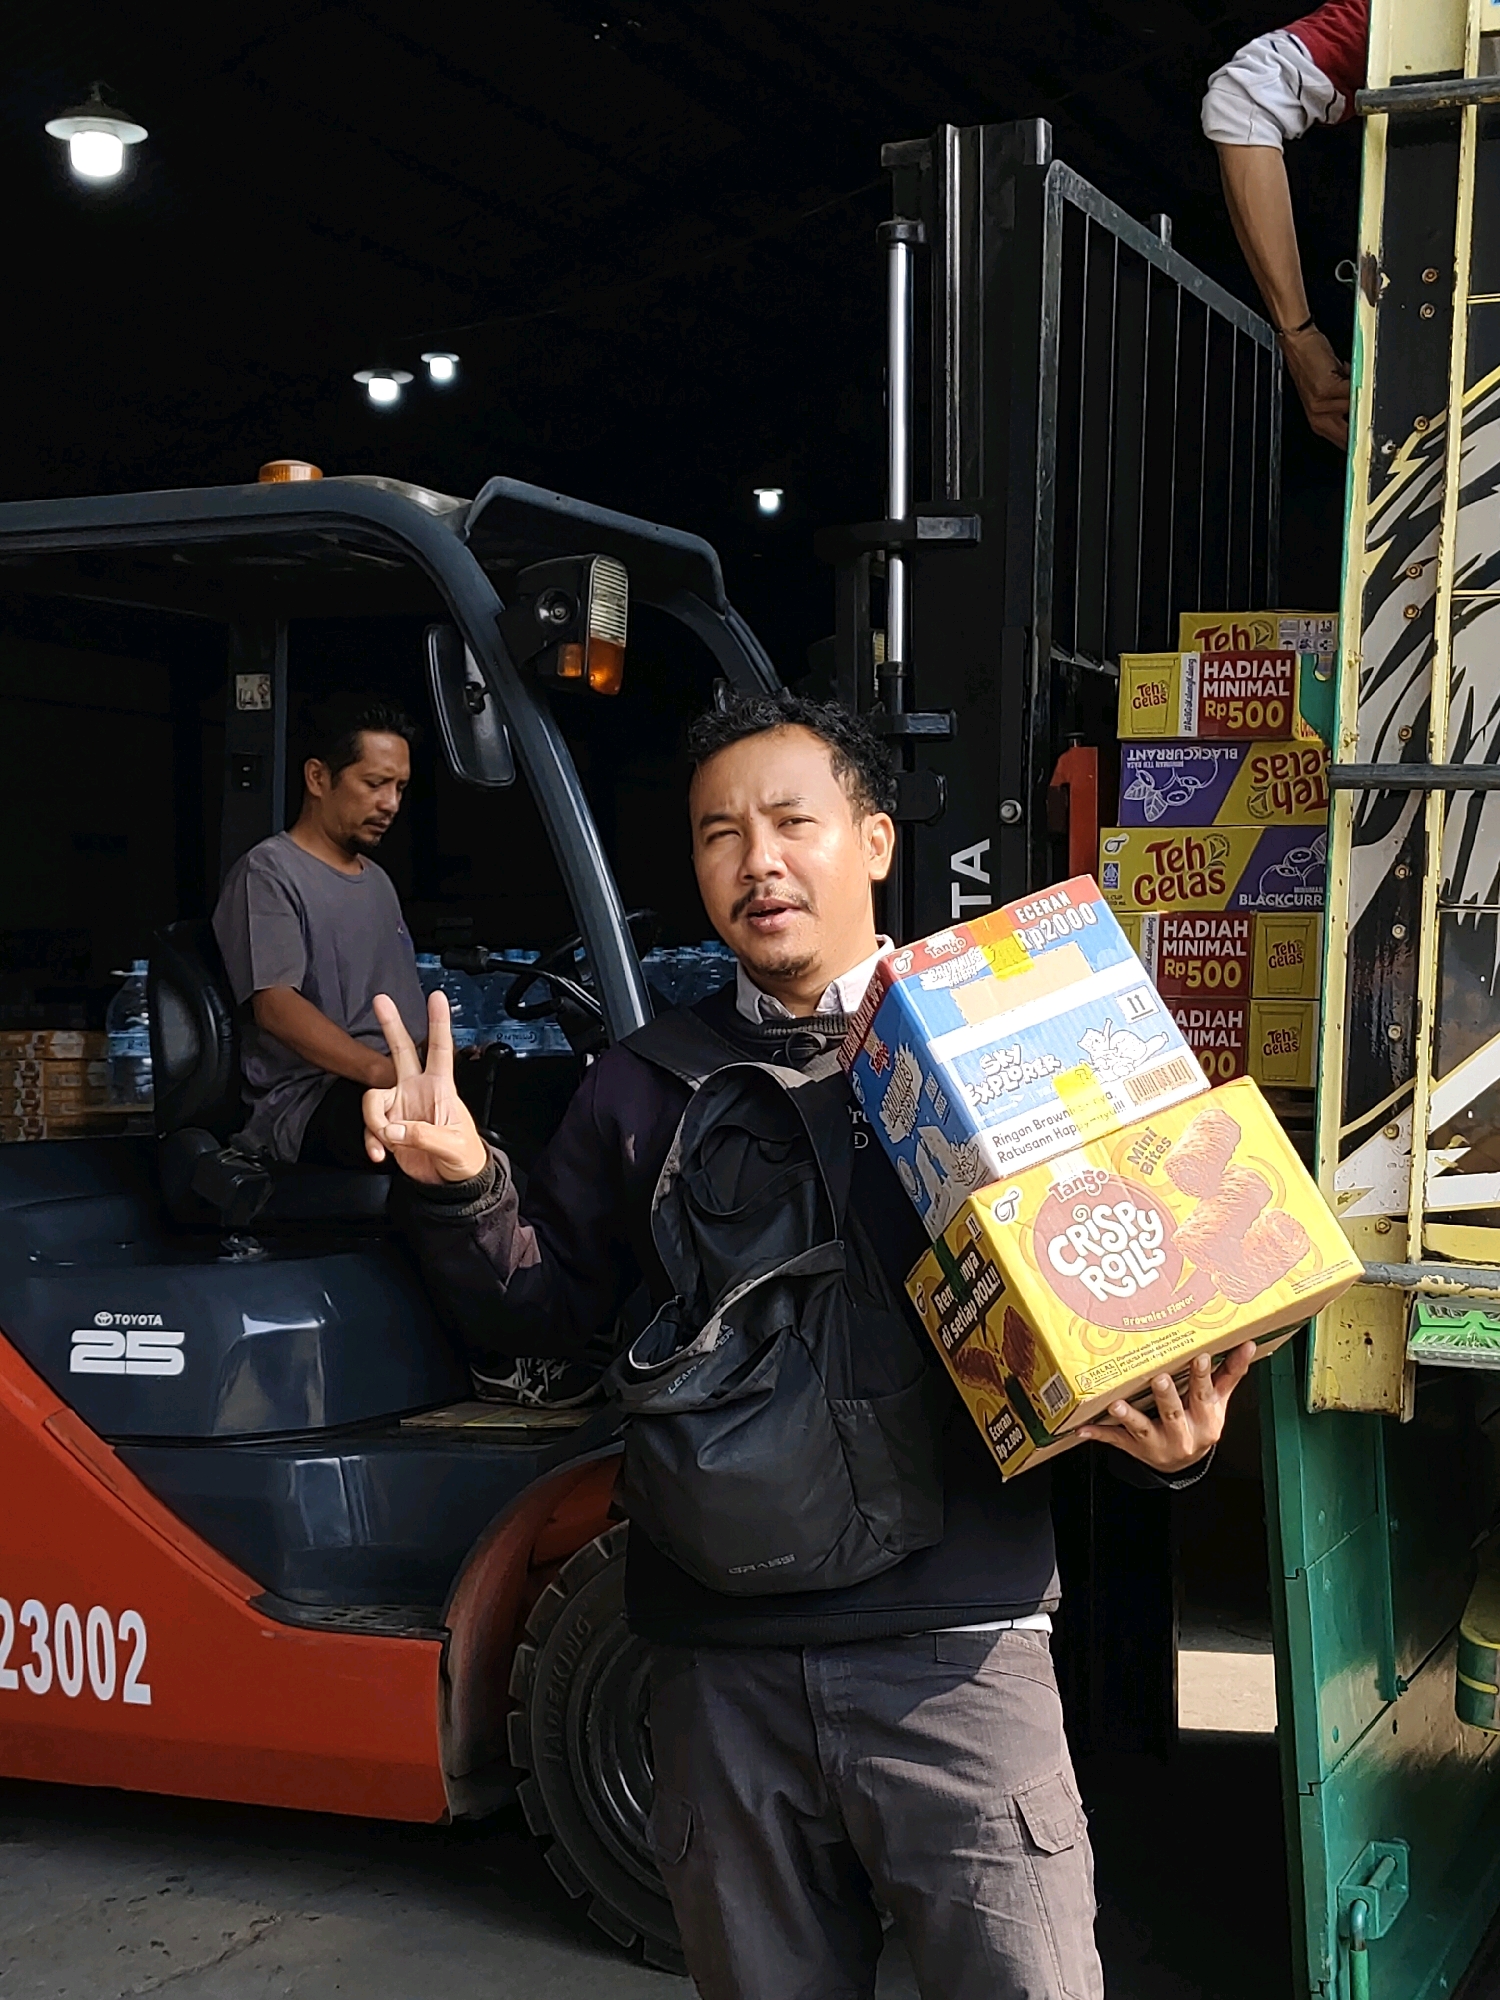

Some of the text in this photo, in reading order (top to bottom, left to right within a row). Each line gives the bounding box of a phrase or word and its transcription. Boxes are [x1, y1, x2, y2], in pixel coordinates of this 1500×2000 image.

[1194, 624, 1250, 651] Teh
[1203, 659, 1291, 679] HADIAH
[1132, 693, 1167, 710] Gelas
[1136, 681, 1160, 698] Teh
[1202, 680, 1290, 698] MINIMAL
[1204, 700, 1284, 729] Rp500
[1127, 748, 1238, 762] BLACKCURRANT
[1250, 748, 1331, 784] elas
[1145, 836, 1206, 876] Teh
[1133, 868, 1226, 906] Gelas
[1238, 893, 1324, 906] BLACKCURR
[1014, 890, 1072, 924] ECERAN
[1012, 902, 1098, 952] Rp2000
[1163, 920, 1248, 938] HADIAH
[927, 937, 967, 957] Tango
[1162, 939, 1247, 957] MINIMAL
[1272, 940, 1296, 956] Teh
[1164, 959, 1242, 988] Rp500
[1268, 954, 1304, 969] Gelas
[1170, 1009, 1243, 1028] ADIAH
[1181, 1029, 1242, 1047] NIMAL
[1263, 1040, 1299, 1056] Gelas
[1267, 1028, 1291, 1044] Teh
[980, 1043, 1021, 1076] SKY
[882, 1052, 914, 1127] BROWNIES
[965, 1054, 1062, 1107] EXPLORER
[992, 1123, 1033, 1148] Ringan
[997, 1132, 1053, 1164] Ratusann
[1127, 1126, 1157, 1165] Mini
[1140, 1136, 1172, 1176] Bites
[1049, 1169, 1108, 1201] Tango
[114, 1314, 163, 1326] TOYOTA
[941, 1265, 1000, 1350] di setiap ROLL!!
[1122, 1294, 1197, 1327] Brownies Flavor
[69, 1330, 185, 1376] 25
[1089, 1363, 1115, 1378] HALAL
[988, 1413, 1012, 1441] Eceran
[995, 1443, 1008, 1460] Rp
[0, 1597, 152, 1705] 23002
